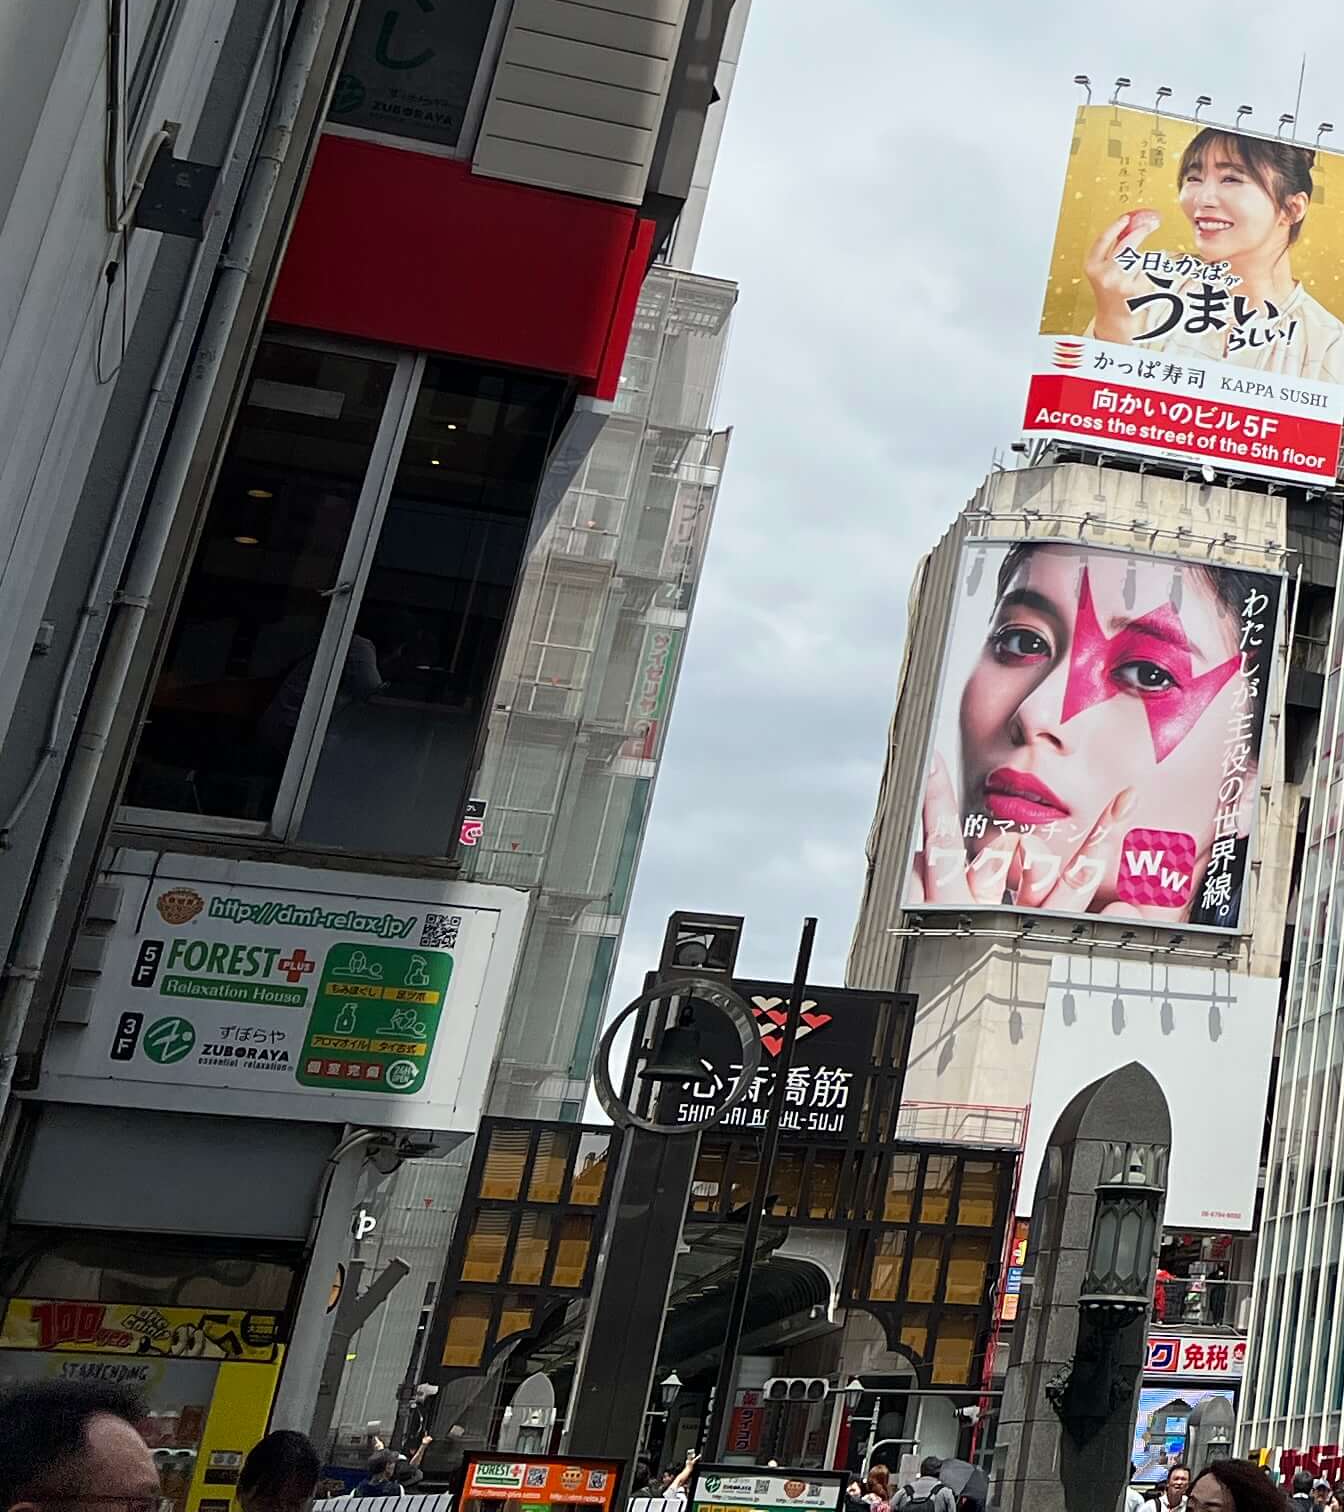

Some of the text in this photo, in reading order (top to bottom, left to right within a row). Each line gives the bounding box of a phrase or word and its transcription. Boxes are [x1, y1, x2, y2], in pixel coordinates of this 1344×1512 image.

[1114, 245, 1241, 286] 今日もかっぱが
[1125, 273, 1280, 342] うまい
[1228, 319, 1298, 353] らしい!
[1092, 350, 1207, 390] かっぱ寿司
[1220, 375, 1329, 409] KAPPA SUSHI
[1034, 406, 1327, 470] Across the street of the 5th floor
[1201, 586, 1270, 917] わたしが主役の世界線。
[928, 846, 1107, 894] ワクワク
[209, 897, 416, 938] http://dmt-relax.jp/
[166, 938, 313, 978] FOREST PLUS
[166, 978, 302, 1003] Relaxation House
[331, 984, 377, 998] もみほぐし
[200, 1044, 289, 1063] ZUBORAYA
[219, 1025, 287, 1045] ずぼらや
[313, 1037, 368, 1050] アロマオイル
[682, 1058, 854, 1109] 心斎橋筋
[1183, 1343, 1230, 1371] 免税
[475, 1464, 512, 1477] FOREST
